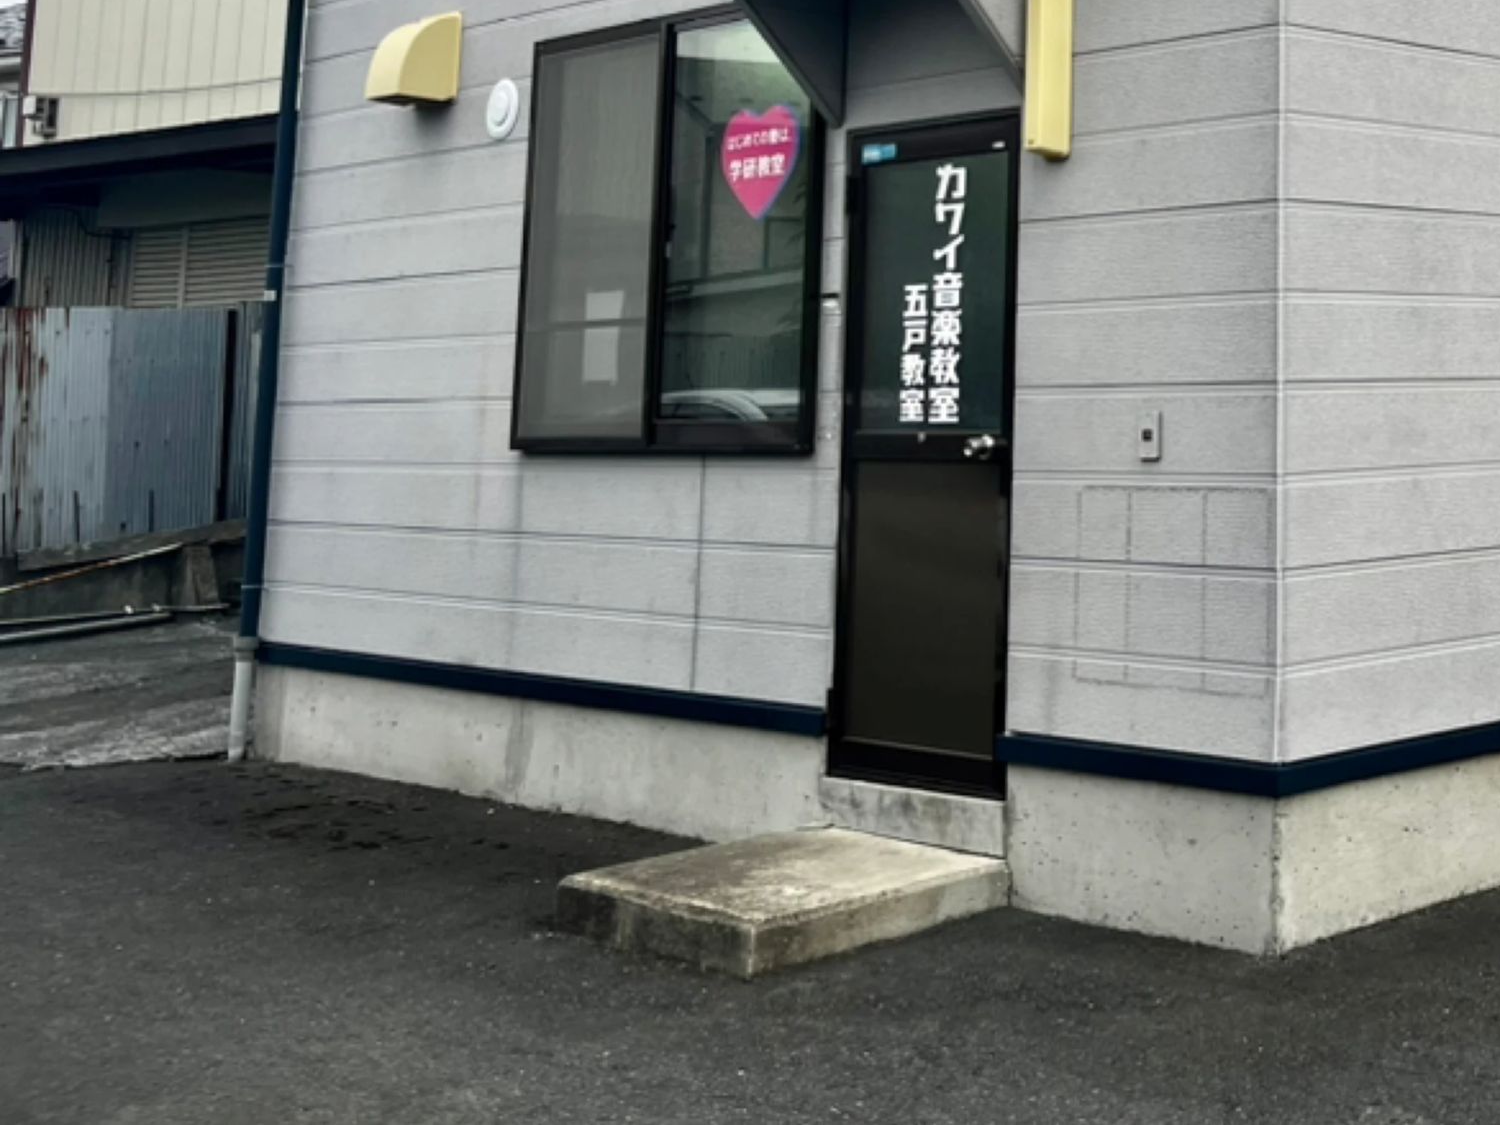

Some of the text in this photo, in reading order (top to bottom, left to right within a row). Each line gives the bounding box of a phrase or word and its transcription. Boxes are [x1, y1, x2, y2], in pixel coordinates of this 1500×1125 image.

[900, 285, 928, 422] 五戸教室
[929, 165, 966, 423] カワイ音楽教室
